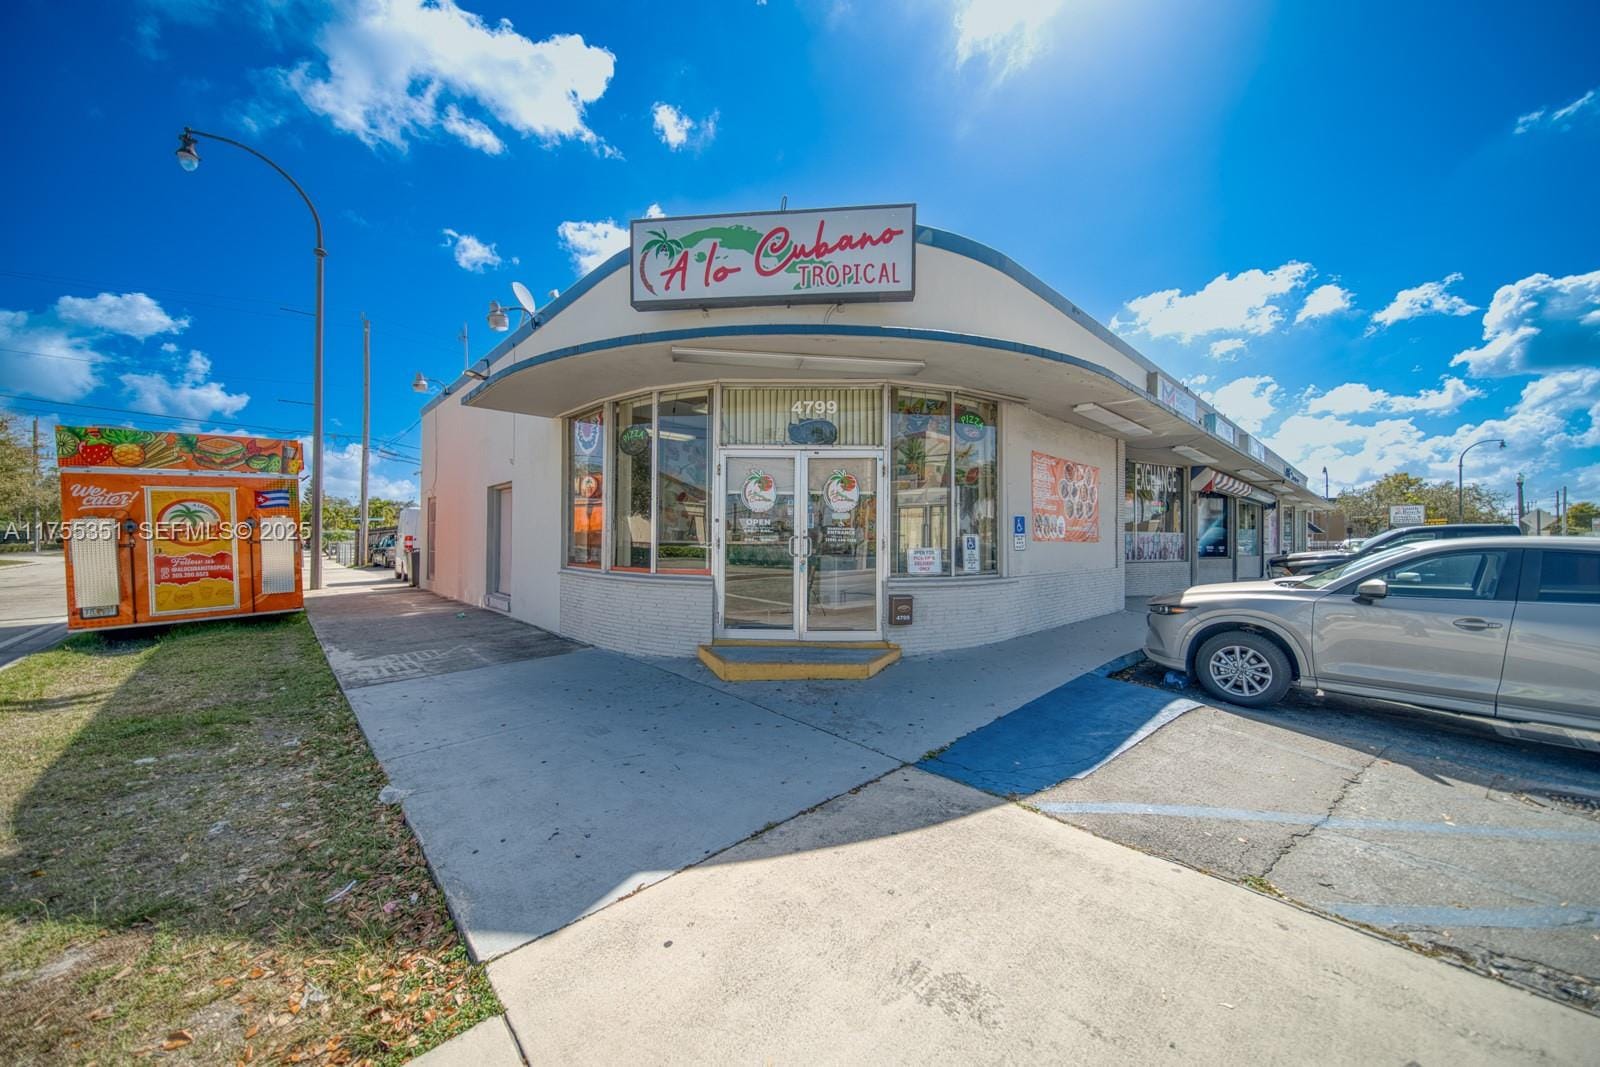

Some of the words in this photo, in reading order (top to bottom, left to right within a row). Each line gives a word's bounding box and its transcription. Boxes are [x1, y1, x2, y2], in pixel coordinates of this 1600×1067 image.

[660, 250, 689, 291] A
[704, 241, 741, 287] lo
[754, 219, 904, 277] Cubano
[798, 262, 901, 287] TROPICAL
[791, 400, 837, 415] 4799
[960, 414, 984, 430] PIZZA
[623, 429, 645, 442] PIZZA
[1135, 463, 1177, 493] EXCHANGE
[70, 483, 107, 497] We
[81, 491, 140, 508] cater!
[745, 518, 771, 526] OPEN
